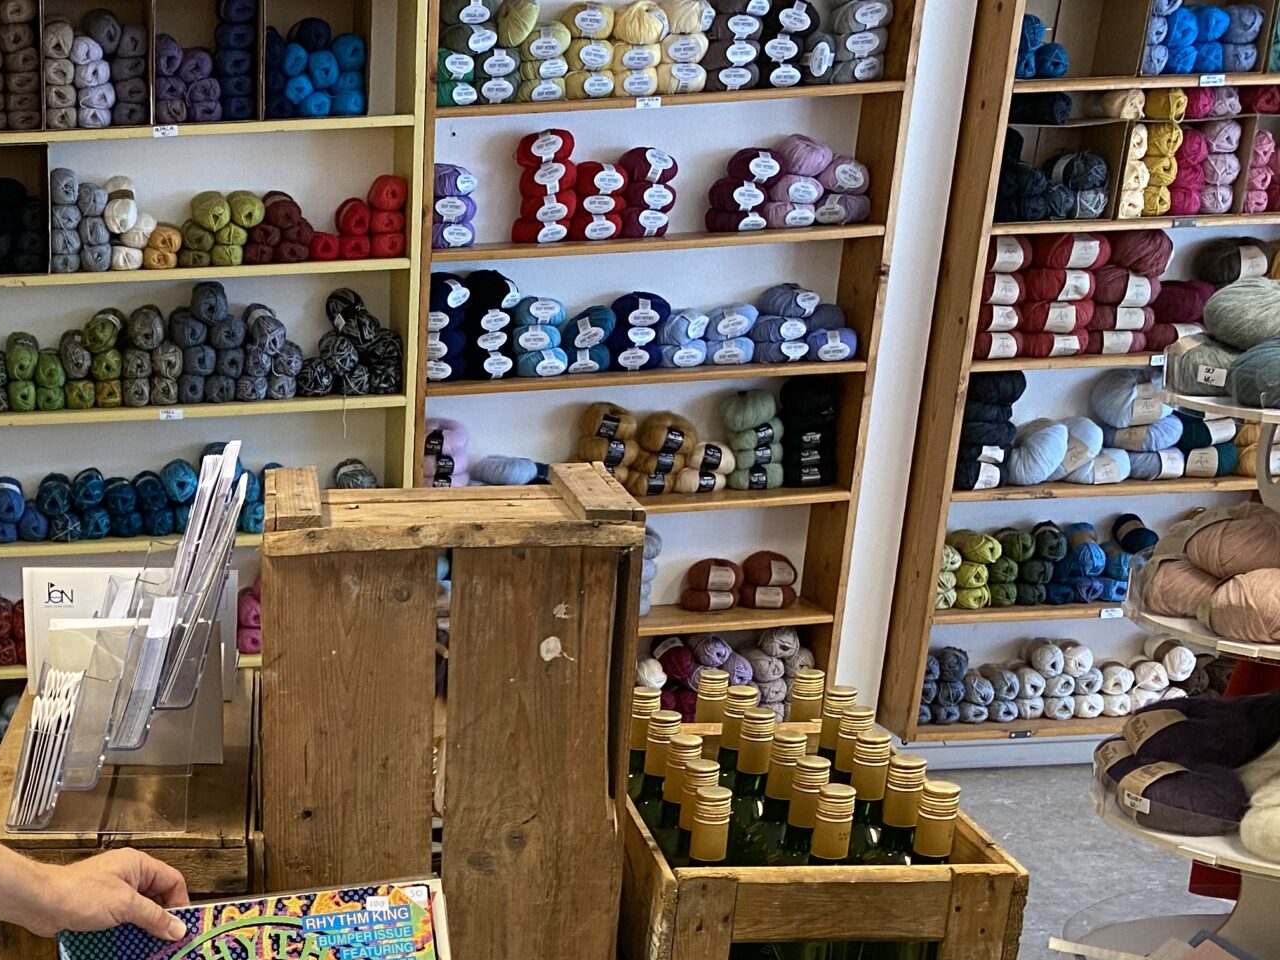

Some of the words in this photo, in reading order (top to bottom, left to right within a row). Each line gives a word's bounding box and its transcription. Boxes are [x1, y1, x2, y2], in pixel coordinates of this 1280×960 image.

[305, 911, 370, 930] RHYTHM
[372, 908, 409, 922] KING
[319, 930, 372, 947] BUMPER
[375, 927, 412, 940] ISSUE
[343, 942, 414, 960] FEATURING
